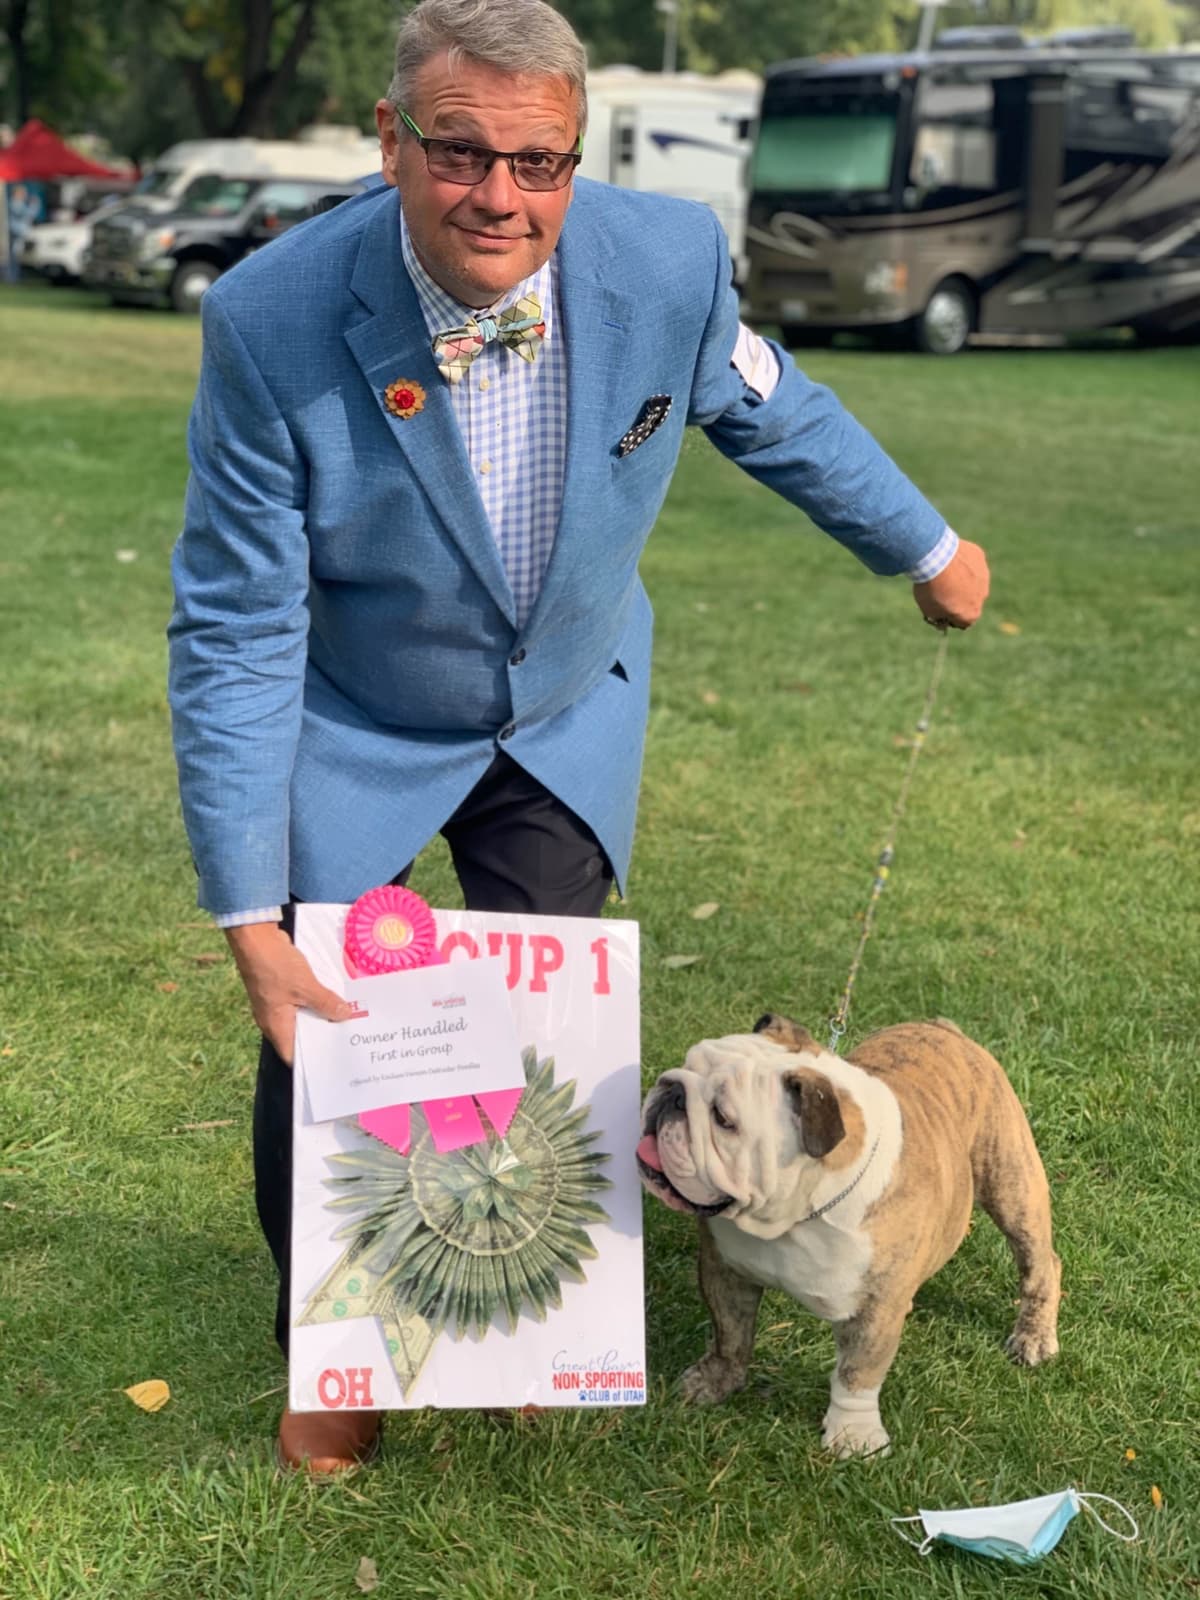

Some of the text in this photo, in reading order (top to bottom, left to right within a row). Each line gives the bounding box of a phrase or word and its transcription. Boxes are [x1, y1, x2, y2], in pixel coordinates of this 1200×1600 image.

[440, 931, 565, 992] OUP
[590, 937, 611, 995] 1
[350, 1017, 469, 1046] Owner Handled
[370, 1043, 453, 1064] First in Group
[552, 1350, 594, 1371] Great
[318, 1368, 374, 1408] OH
[553, 1372, 644, 1390] NON-SPORTING
[588, 1390, 645, 1401] CLUB of UTAH
